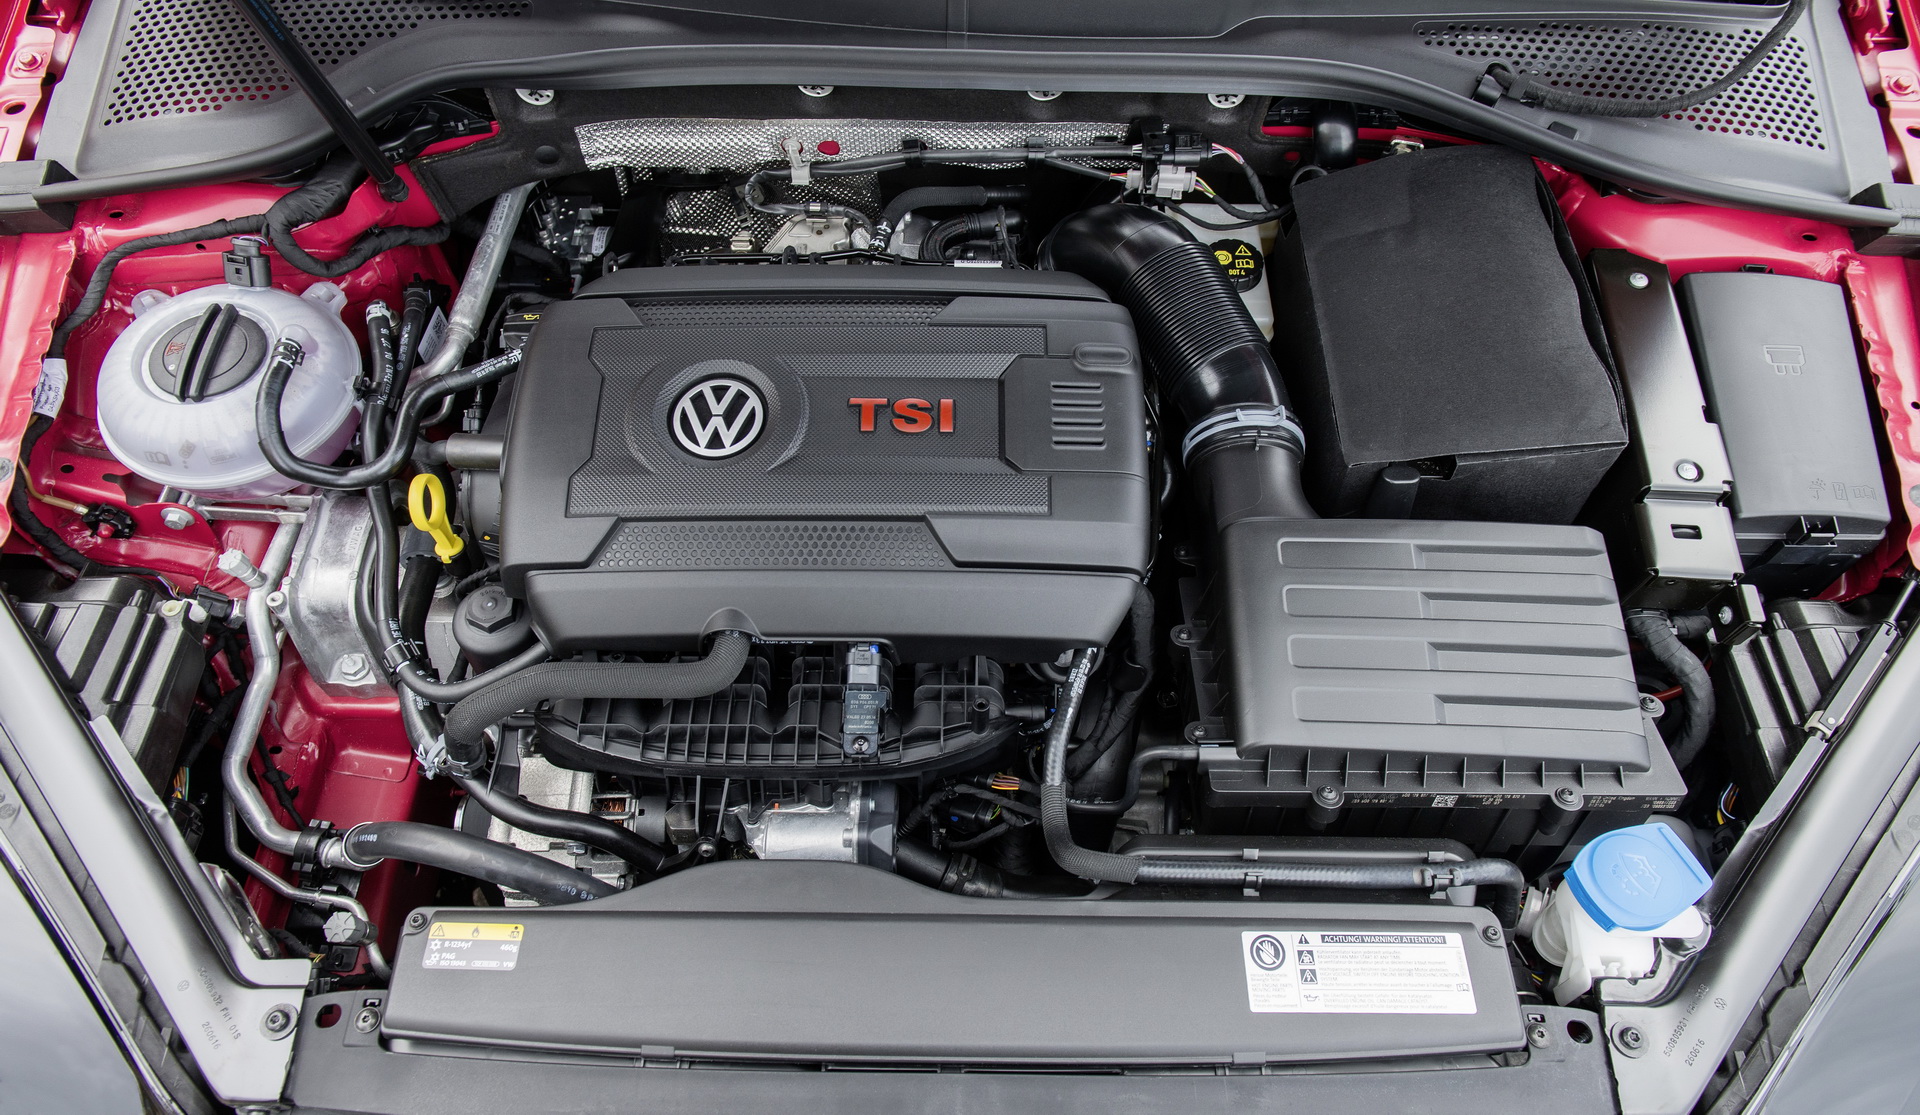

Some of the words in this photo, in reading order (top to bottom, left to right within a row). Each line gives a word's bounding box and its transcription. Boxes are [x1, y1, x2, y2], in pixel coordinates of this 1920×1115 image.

[673, 379, 764, 457] VW
[848, 397, 954, 434] TSI
[500, 944, 519, 953] 460g
[1324, 935, 1362, 943] ACHTUNG!
[1363, 936, 1401, 944] WARNING!
[1402, 936, 1444, 944] ATTENTION!
[202, 1021, 221, 1050] 260616
[1684, 1038, 1706, 1067] 260616
